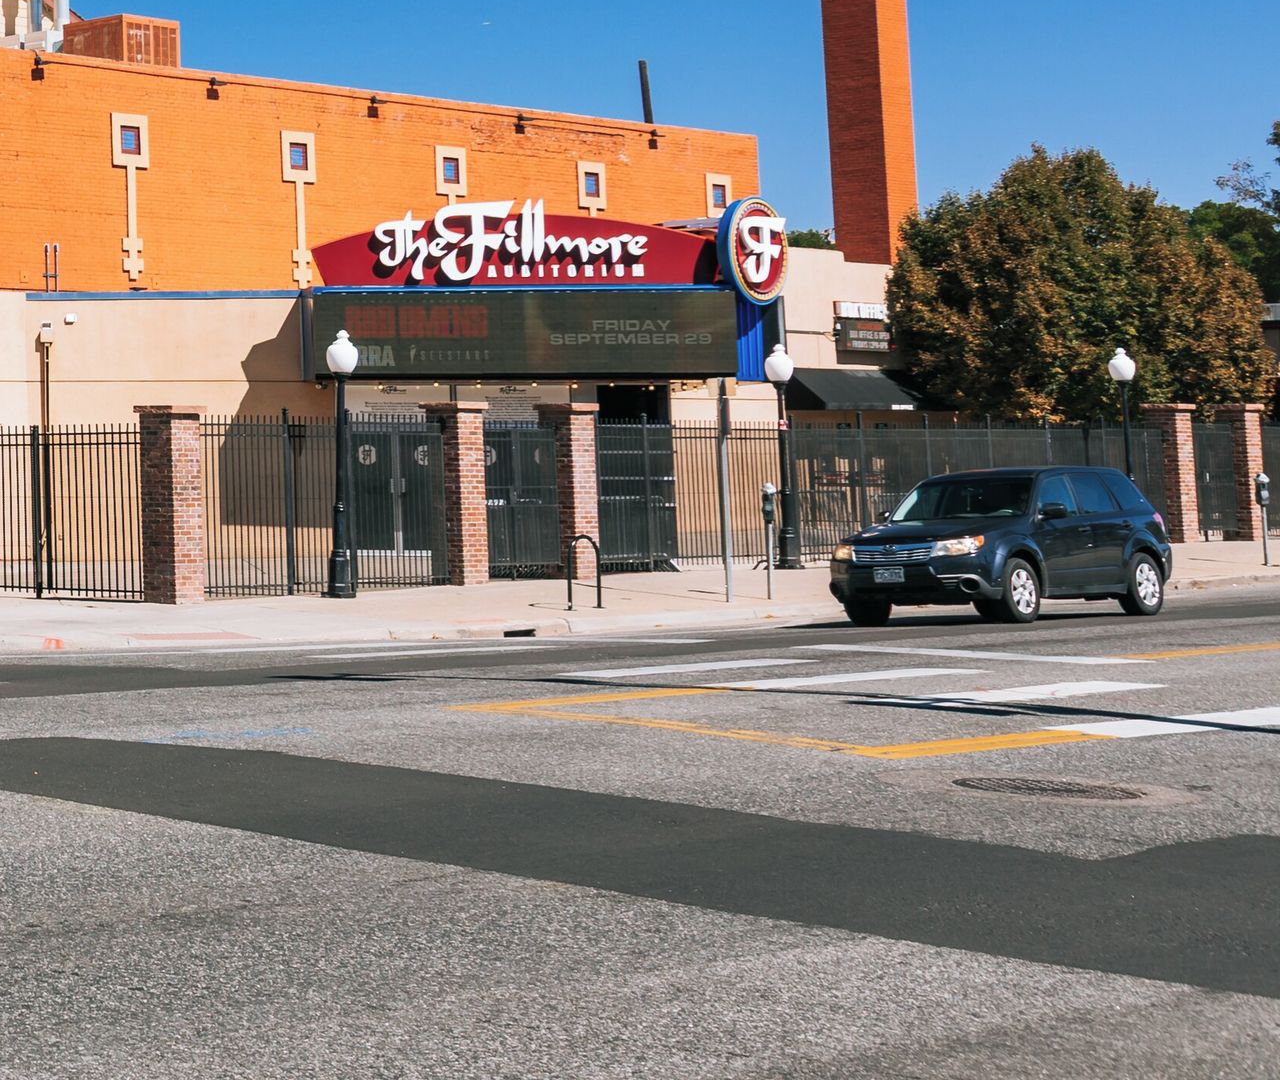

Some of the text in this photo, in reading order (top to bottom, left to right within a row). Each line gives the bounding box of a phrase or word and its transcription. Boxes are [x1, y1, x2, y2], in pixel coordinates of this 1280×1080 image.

[374, 198, 648, 281] The Fillmore
[739, 216, 787, 283] F
[487, 263, 646, 279] AUDITORIUM
[592, 319, 671, 331] FRIDAY
[550, 333, 713, 345] SEPTEMBER 29
[357, 345, 396, 367] RRA
